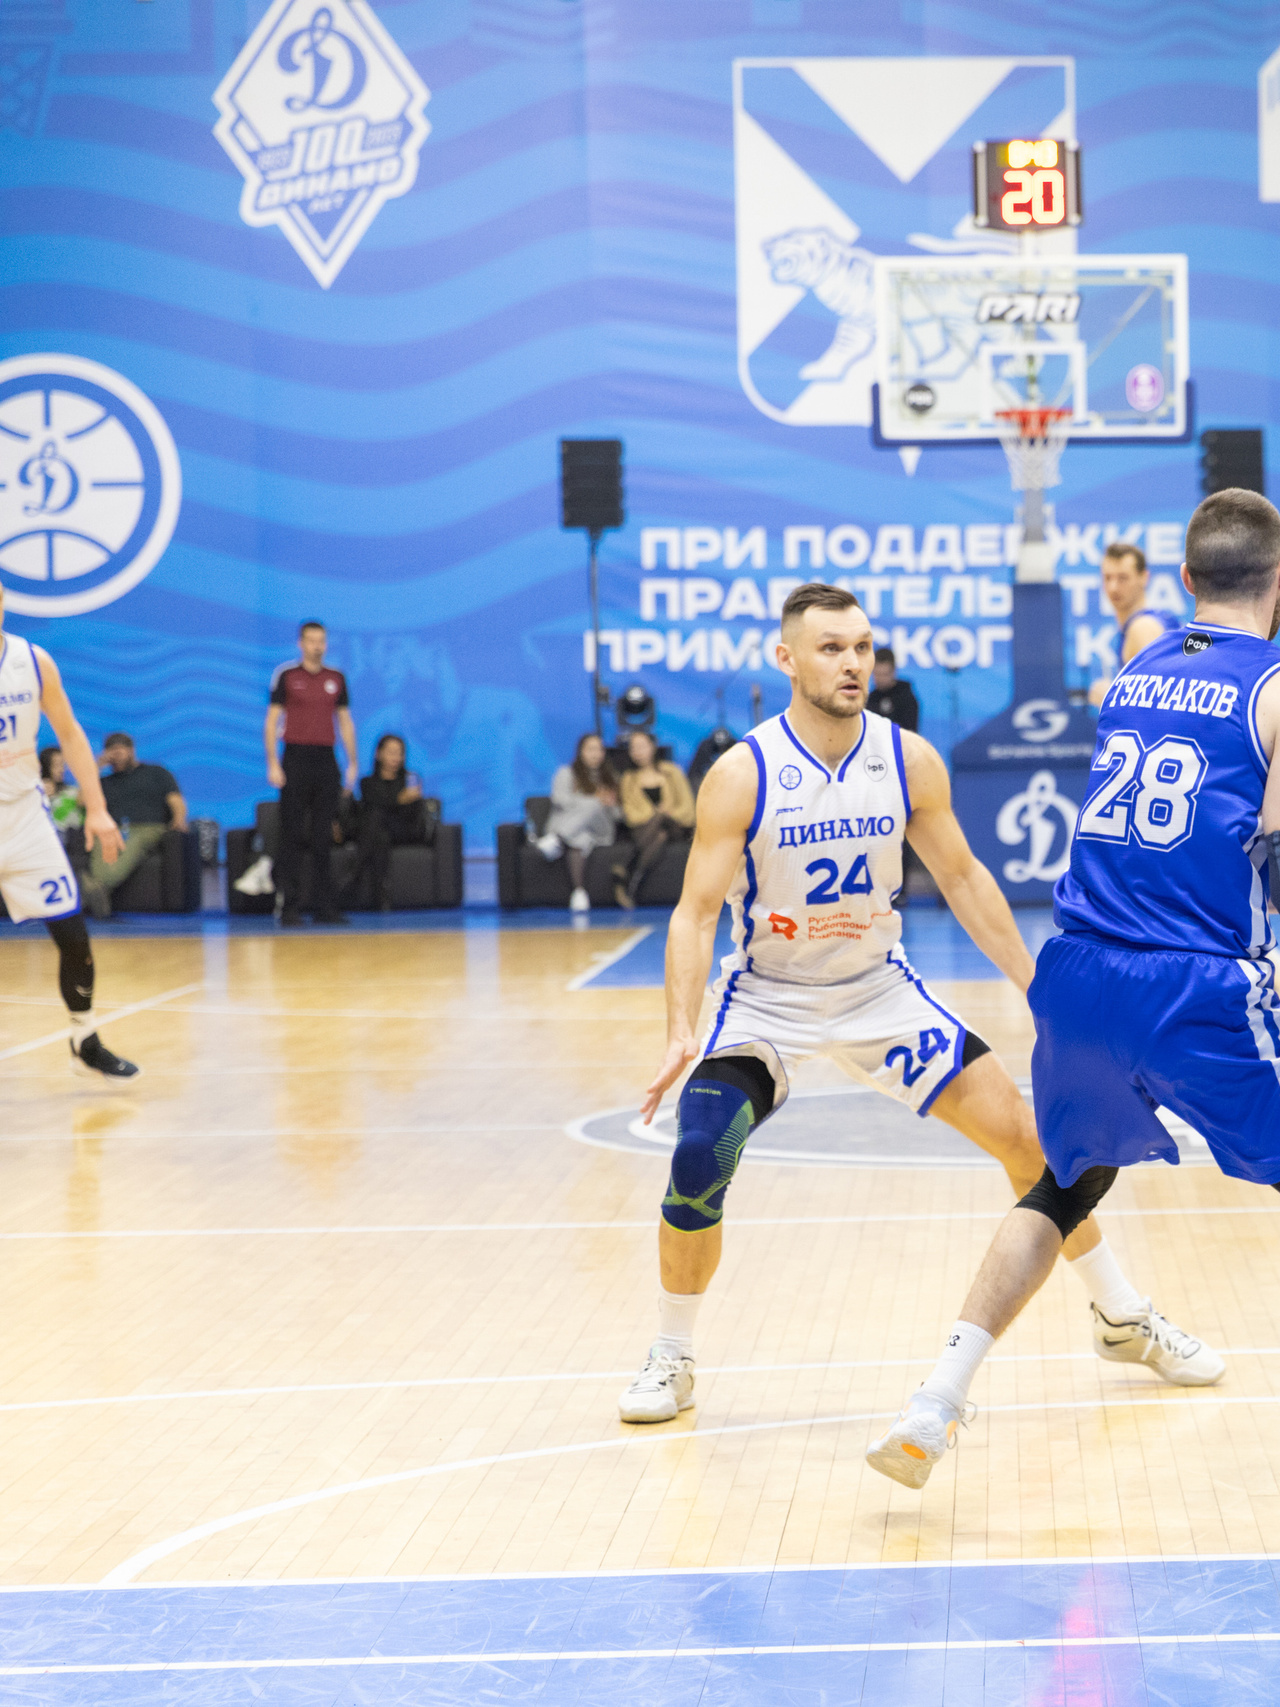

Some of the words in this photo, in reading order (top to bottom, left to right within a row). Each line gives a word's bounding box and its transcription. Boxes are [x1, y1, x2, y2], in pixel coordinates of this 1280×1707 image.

[1001, 169, 1065, 225] 20
[978, 294, 1080, 323] PARI
[640, 526, 767, 570] ПРИ
[783, 522, 1184, 573] ПОДДЕЖКЕ
[1186, 638, 1209, 650] РФБ
[1109, 674, 1238, 718] ТУКМАКОВ
[1077, 729, 1209, 852] 28
[778, 816, 895, 849] ДИНАМО
[40, 876, 72, 905] 21
[805, 852, 874, 906] 24
[808, 912, 851, 924] Русская
[885, 1027, 951, 1088] 24
